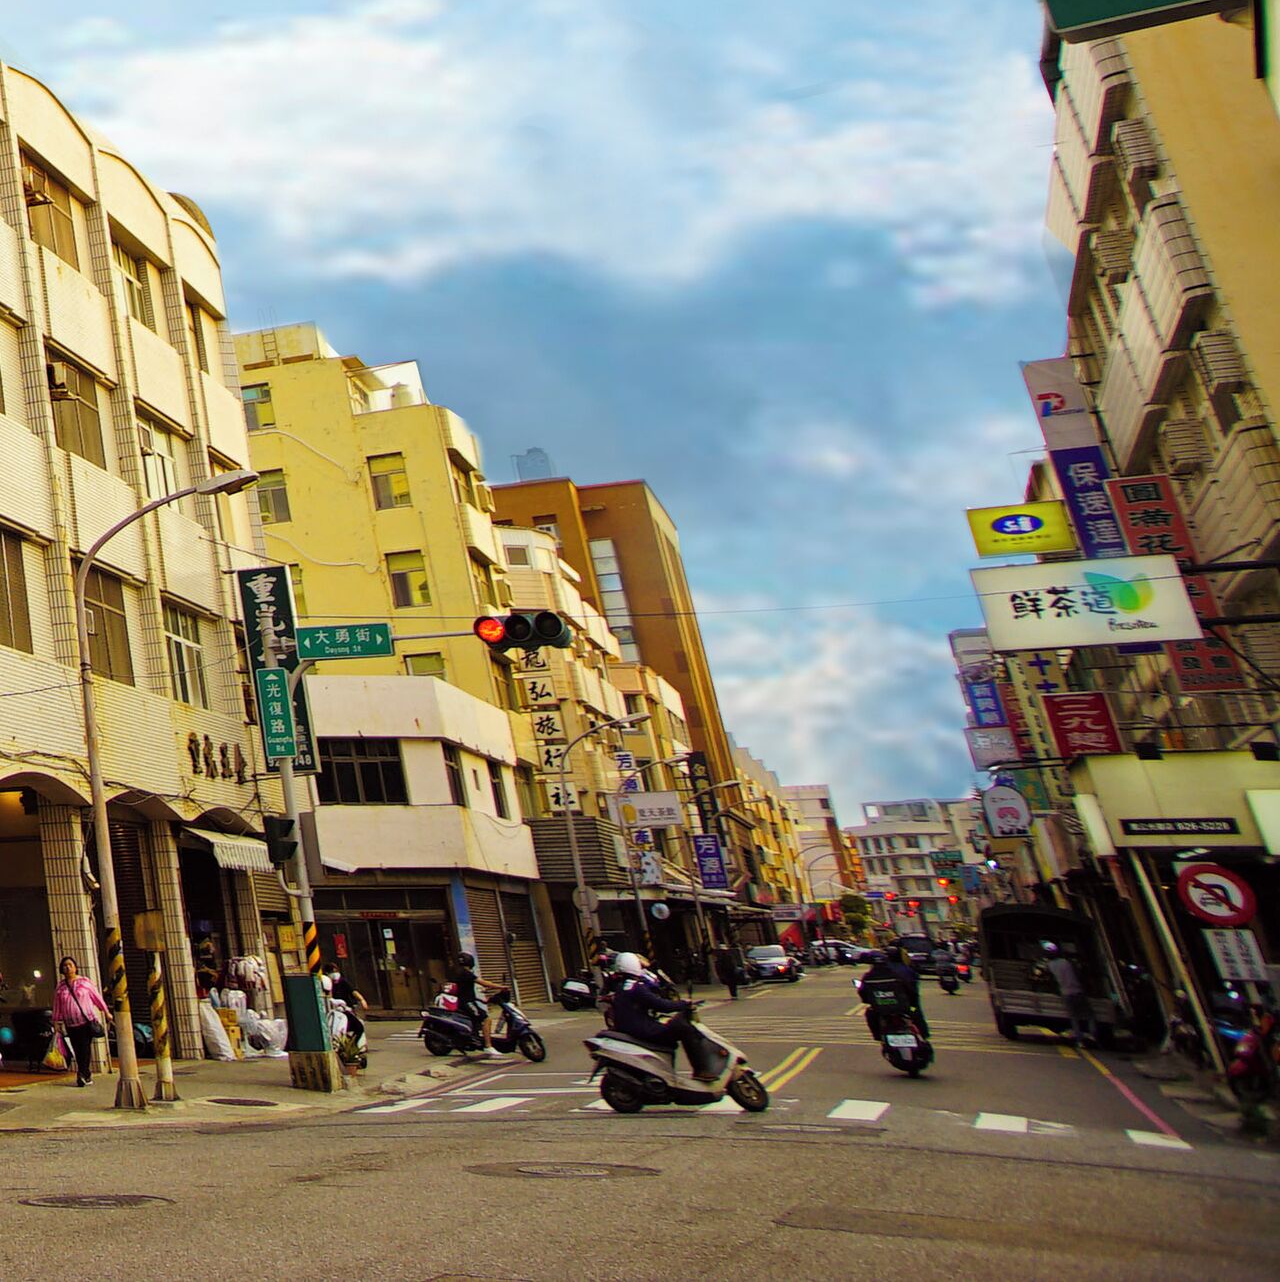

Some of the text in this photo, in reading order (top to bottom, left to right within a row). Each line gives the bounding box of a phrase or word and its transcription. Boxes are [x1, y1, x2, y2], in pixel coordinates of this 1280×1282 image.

[1010, 585, 1119, 620] 鮮茶道
[314, 628, 370, 645] 大勇街
[265, 682, 286, 734] 光復路
